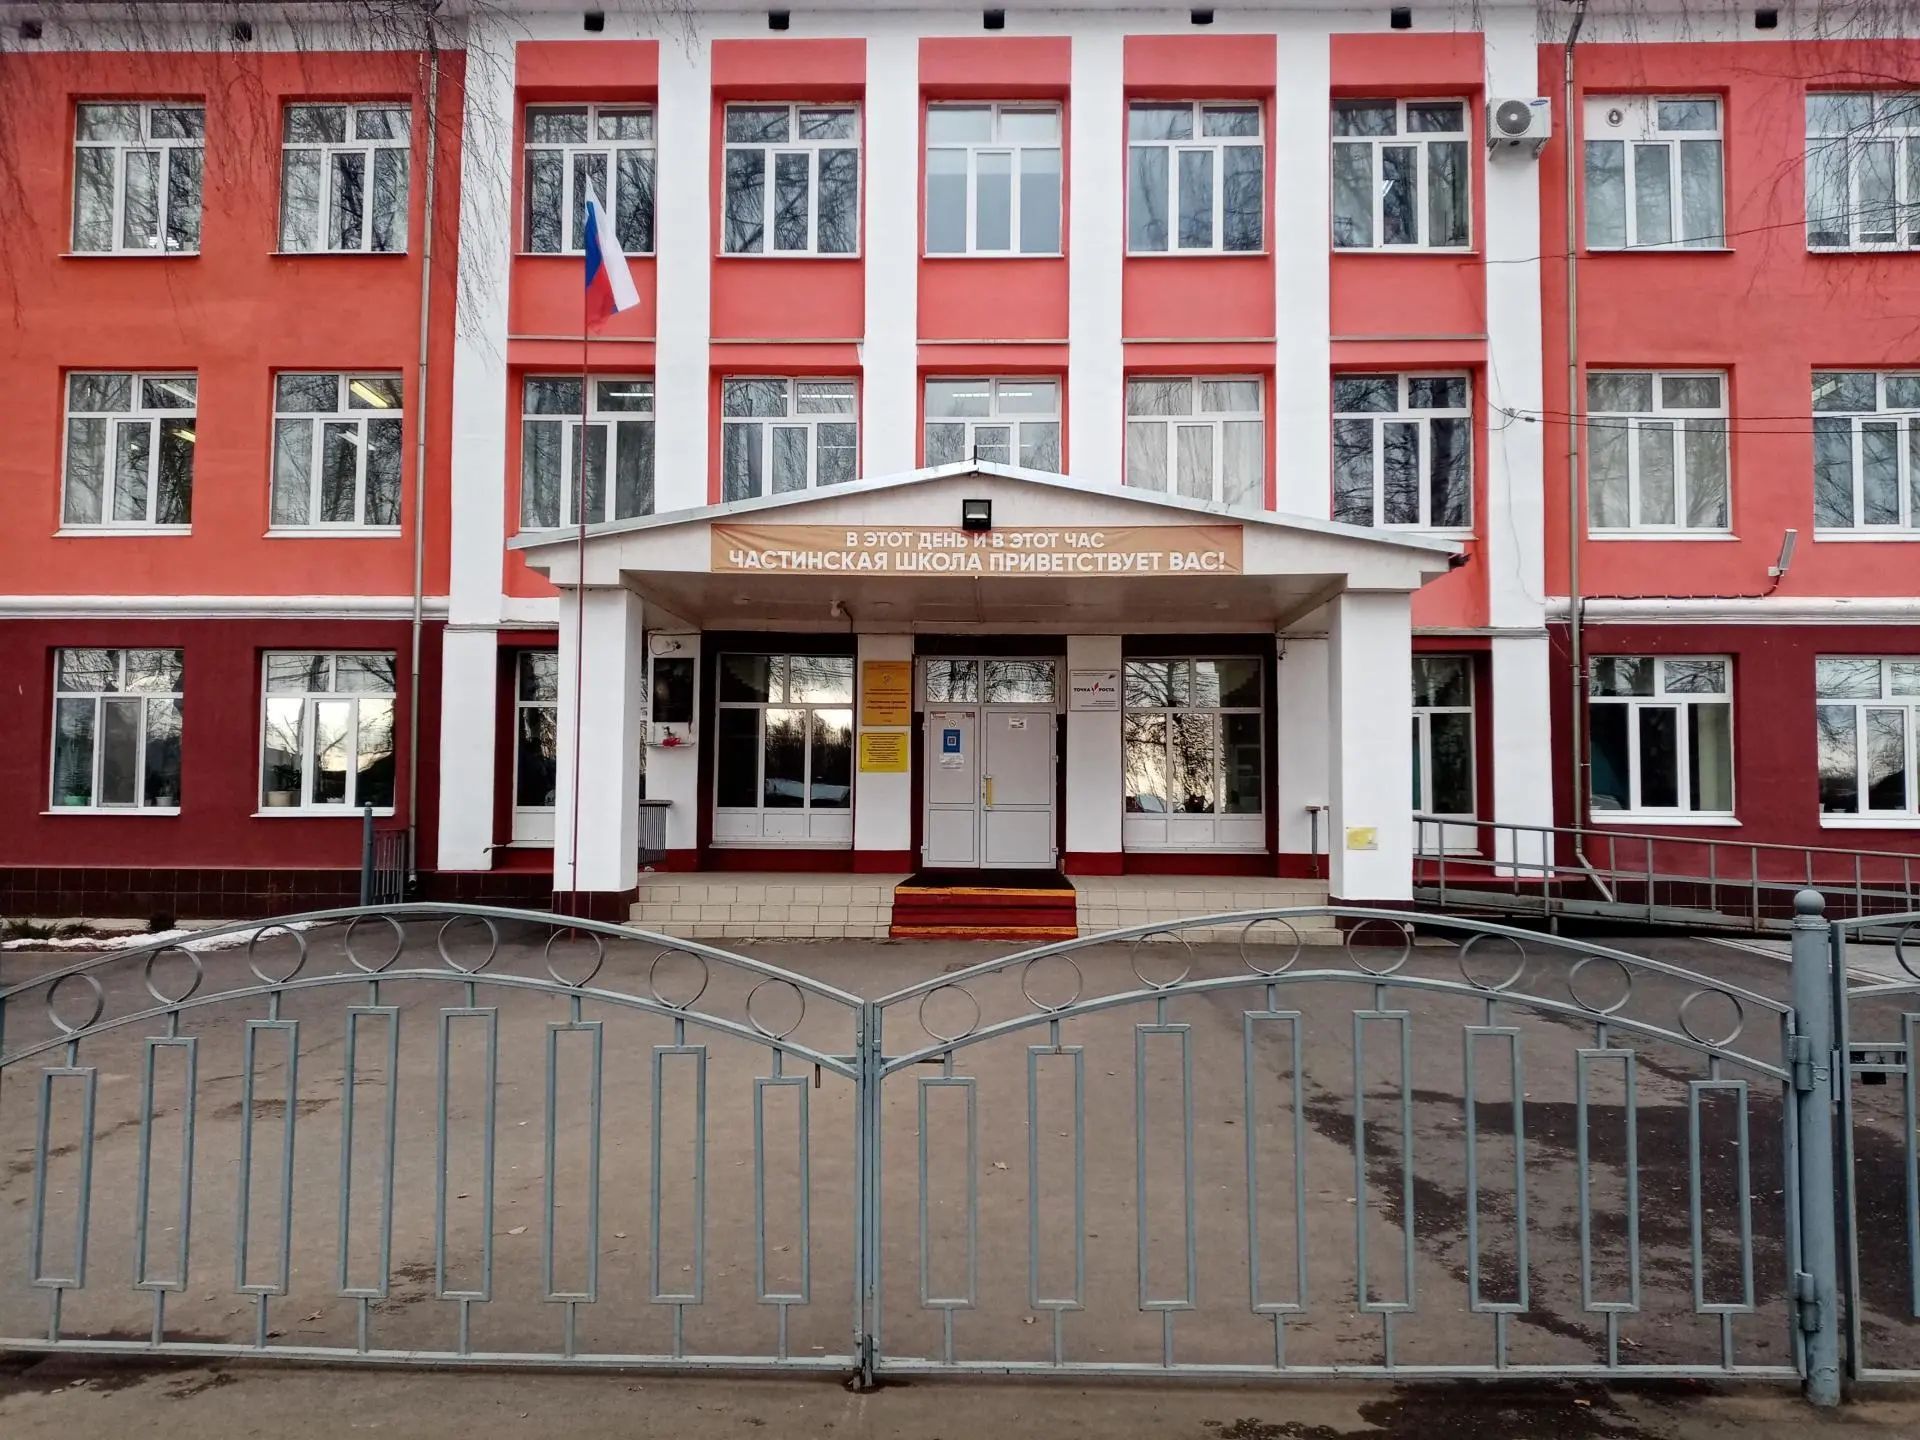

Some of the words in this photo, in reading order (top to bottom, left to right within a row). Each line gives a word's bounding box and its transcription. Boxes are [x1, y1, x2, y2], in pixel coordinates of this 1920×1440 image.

[846, 531, 858, 547] В
[863, 531, 913, 547] ЭТОТ
[918, 531, 968, 550] ДЕНЬ
[973, 533, 986, 548] И
[991, 533, 1004, 548] В
[1009, 532, 1059, 548] ЭТОТ
[1064, 532, 1105, 548] ЧАС
[729, 550, 888, 571] ЧАСТИНСКАЯ
[895, 551, 982, 571] ШКОЛА
[989, 551, 1163, 571] ПРИВЕТСТВУЕТ
[1168, 551, 1225, 571] ВАС!
